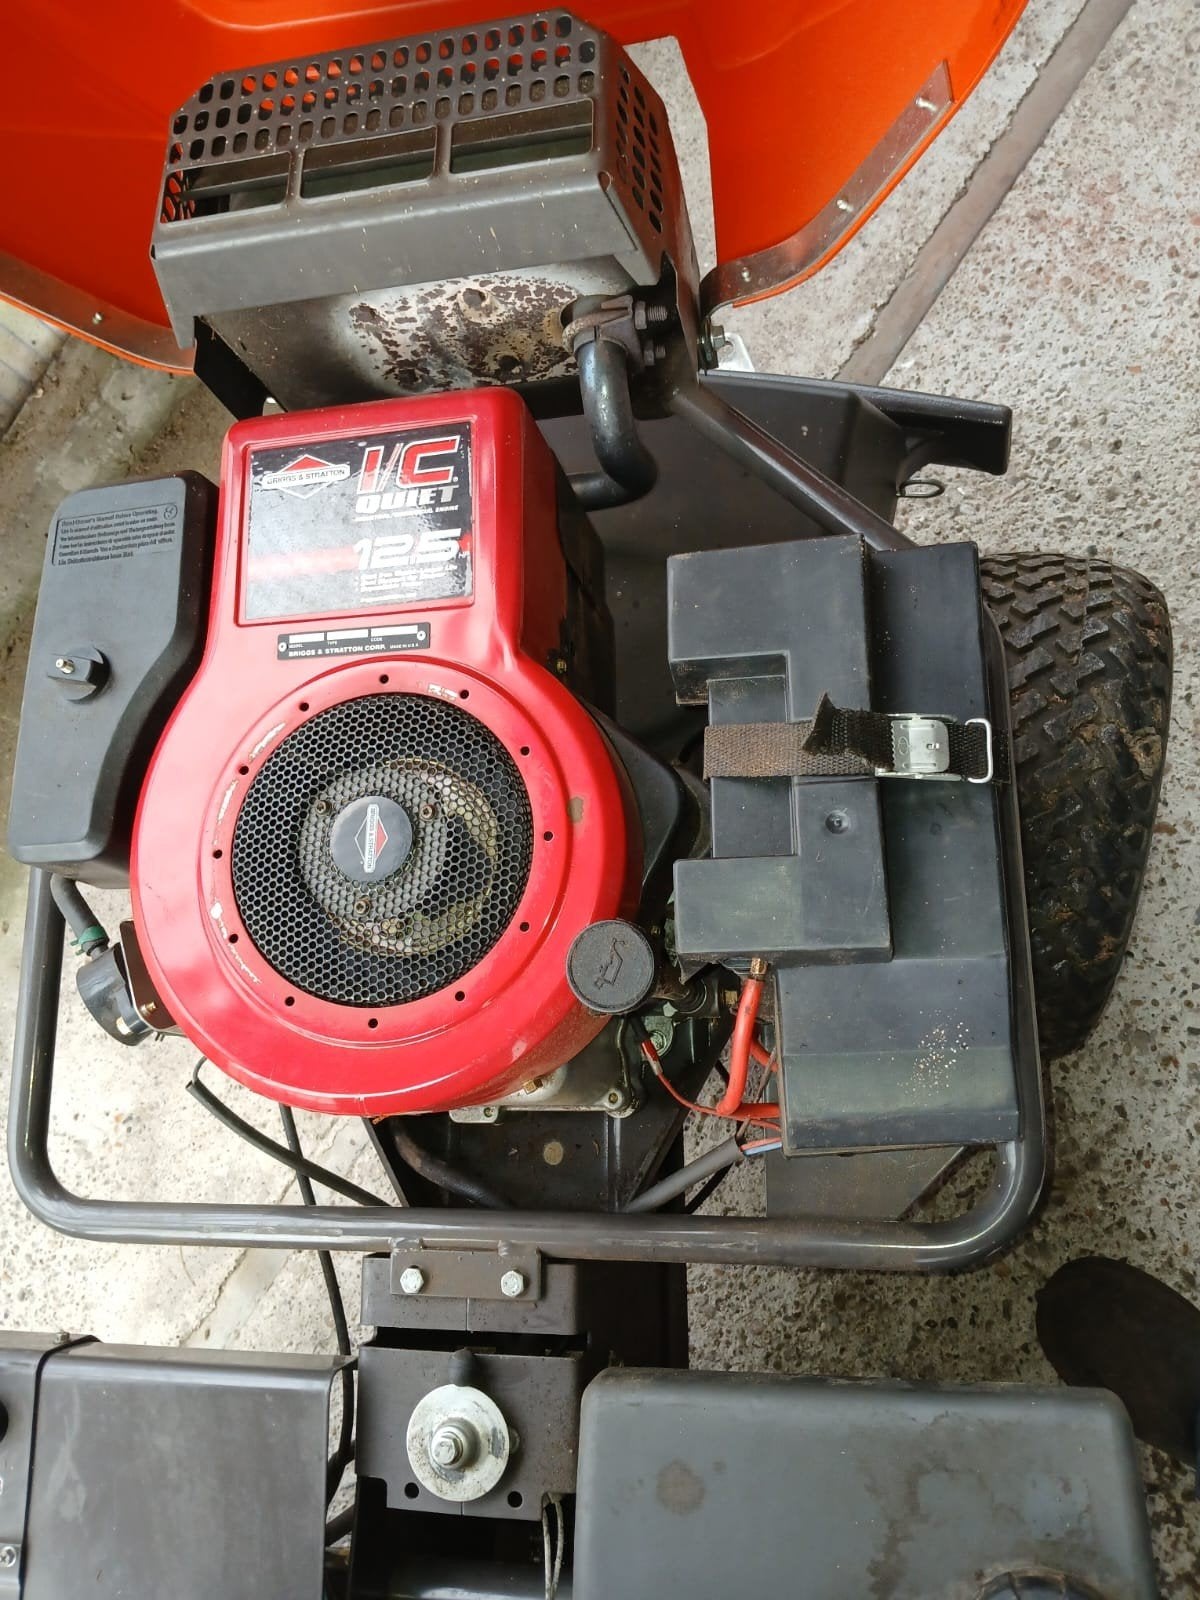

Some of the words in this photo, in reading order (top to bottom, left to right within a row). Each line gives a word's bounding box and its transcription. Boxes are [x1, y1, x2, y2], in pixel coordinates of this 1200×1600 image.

[305, 469, 345, 480] STRATTON
[355, 484, 460, 514] QUIET
[288, 649, 317, 657] BRIGGS
[325, 645, 364, 655] STRATTON
